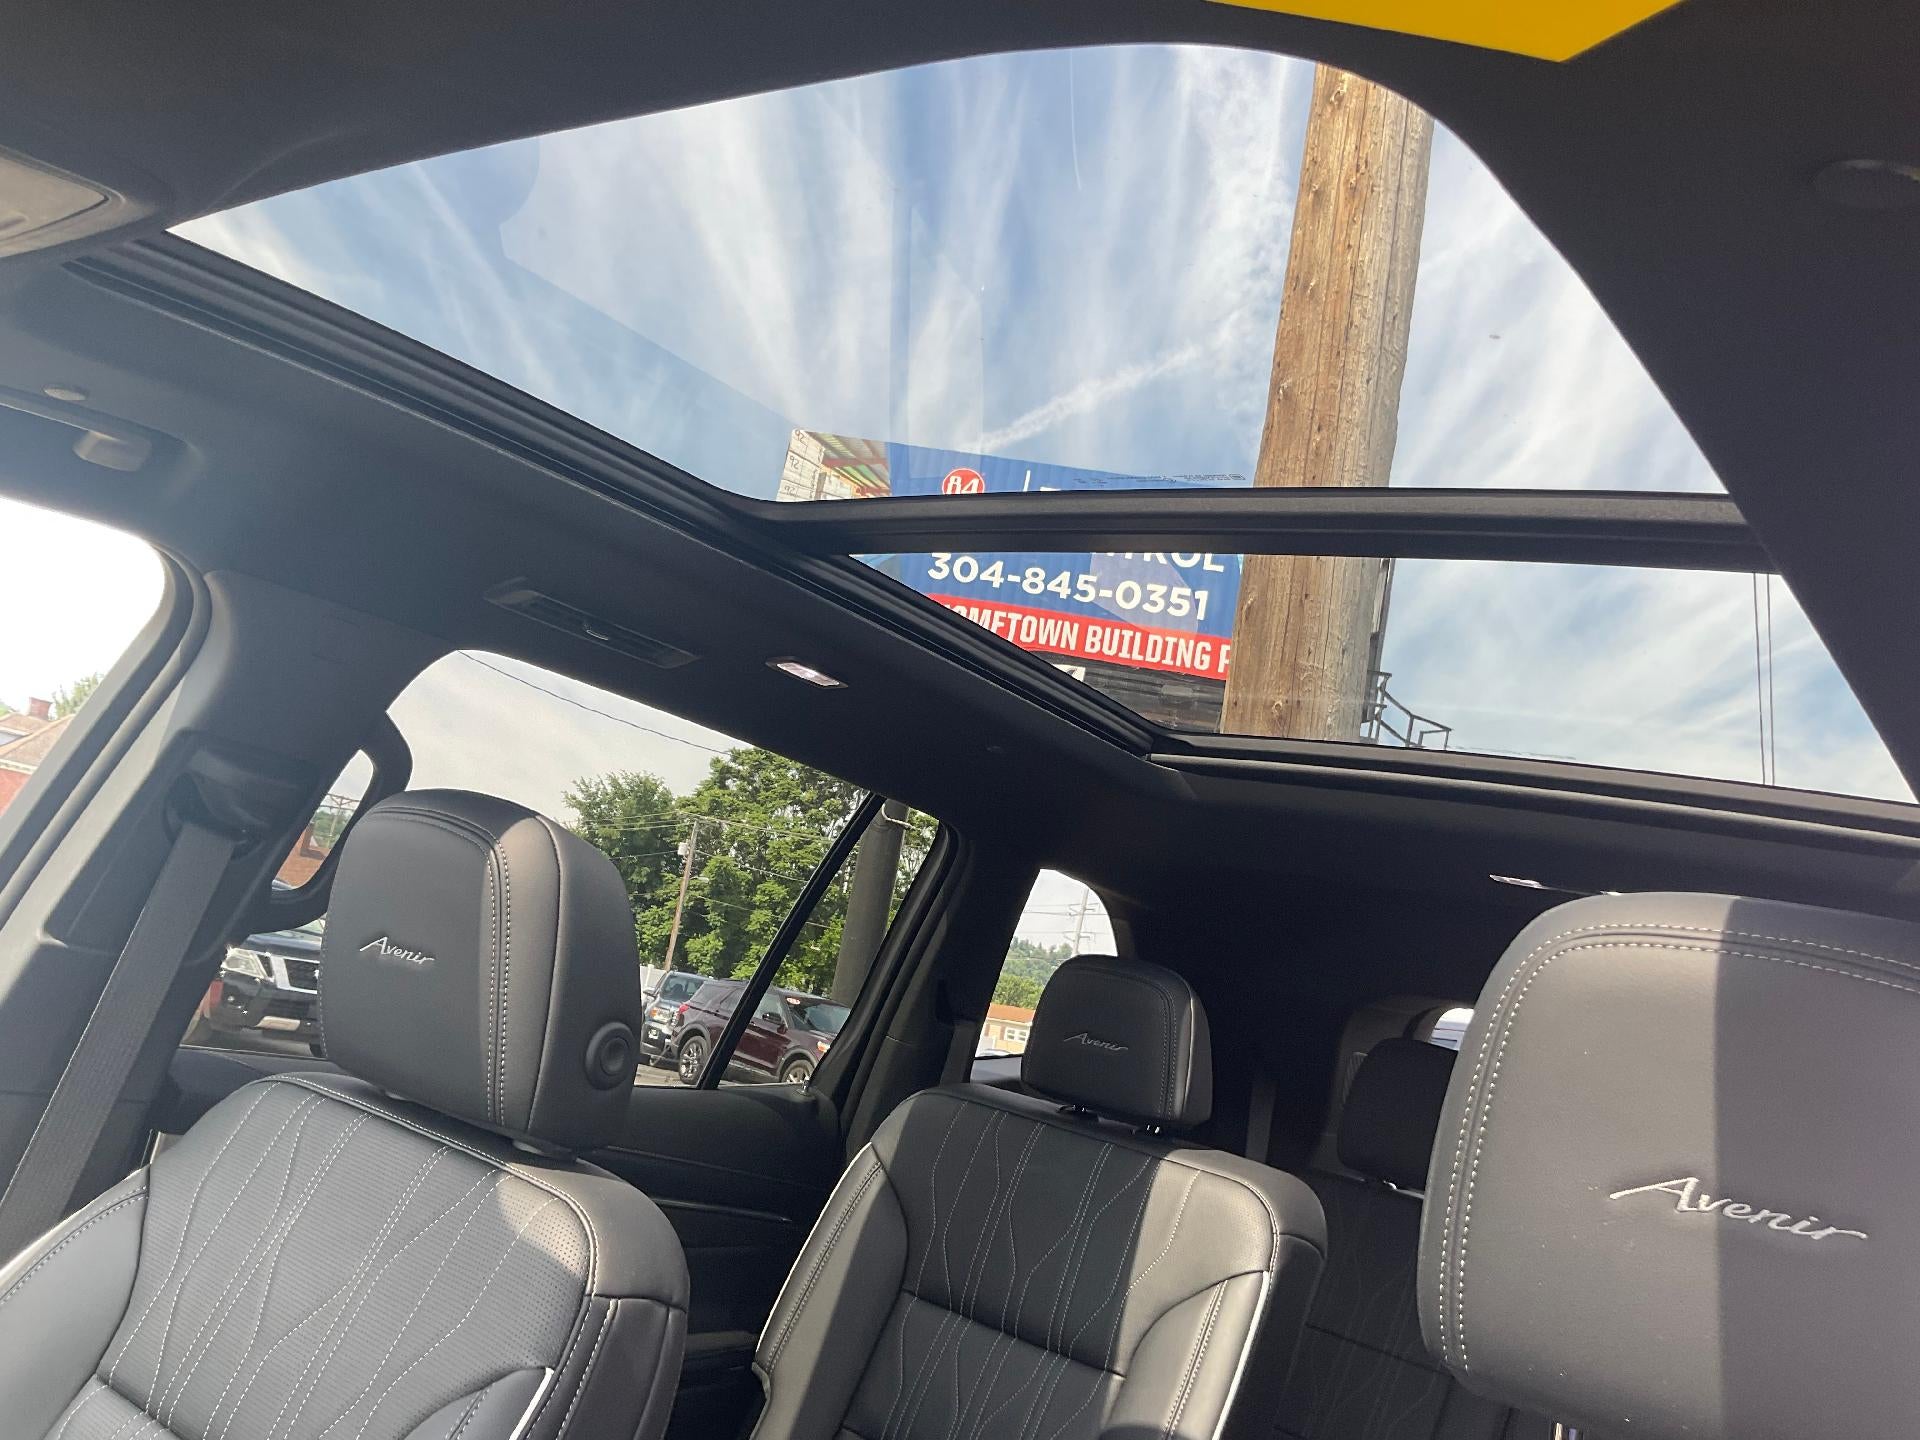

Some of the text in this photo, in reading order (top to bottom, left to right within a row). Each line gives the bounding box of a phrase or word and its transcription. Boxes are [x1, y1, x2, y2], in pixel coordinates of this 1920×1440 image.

[928, 553, 1209, 621] 304-845-0351
[1084, 624, 1211, 671] BUILDING
[359, 936, 435, 965] Avenir
[1609, 1177, 1869, 1240] Avenir
